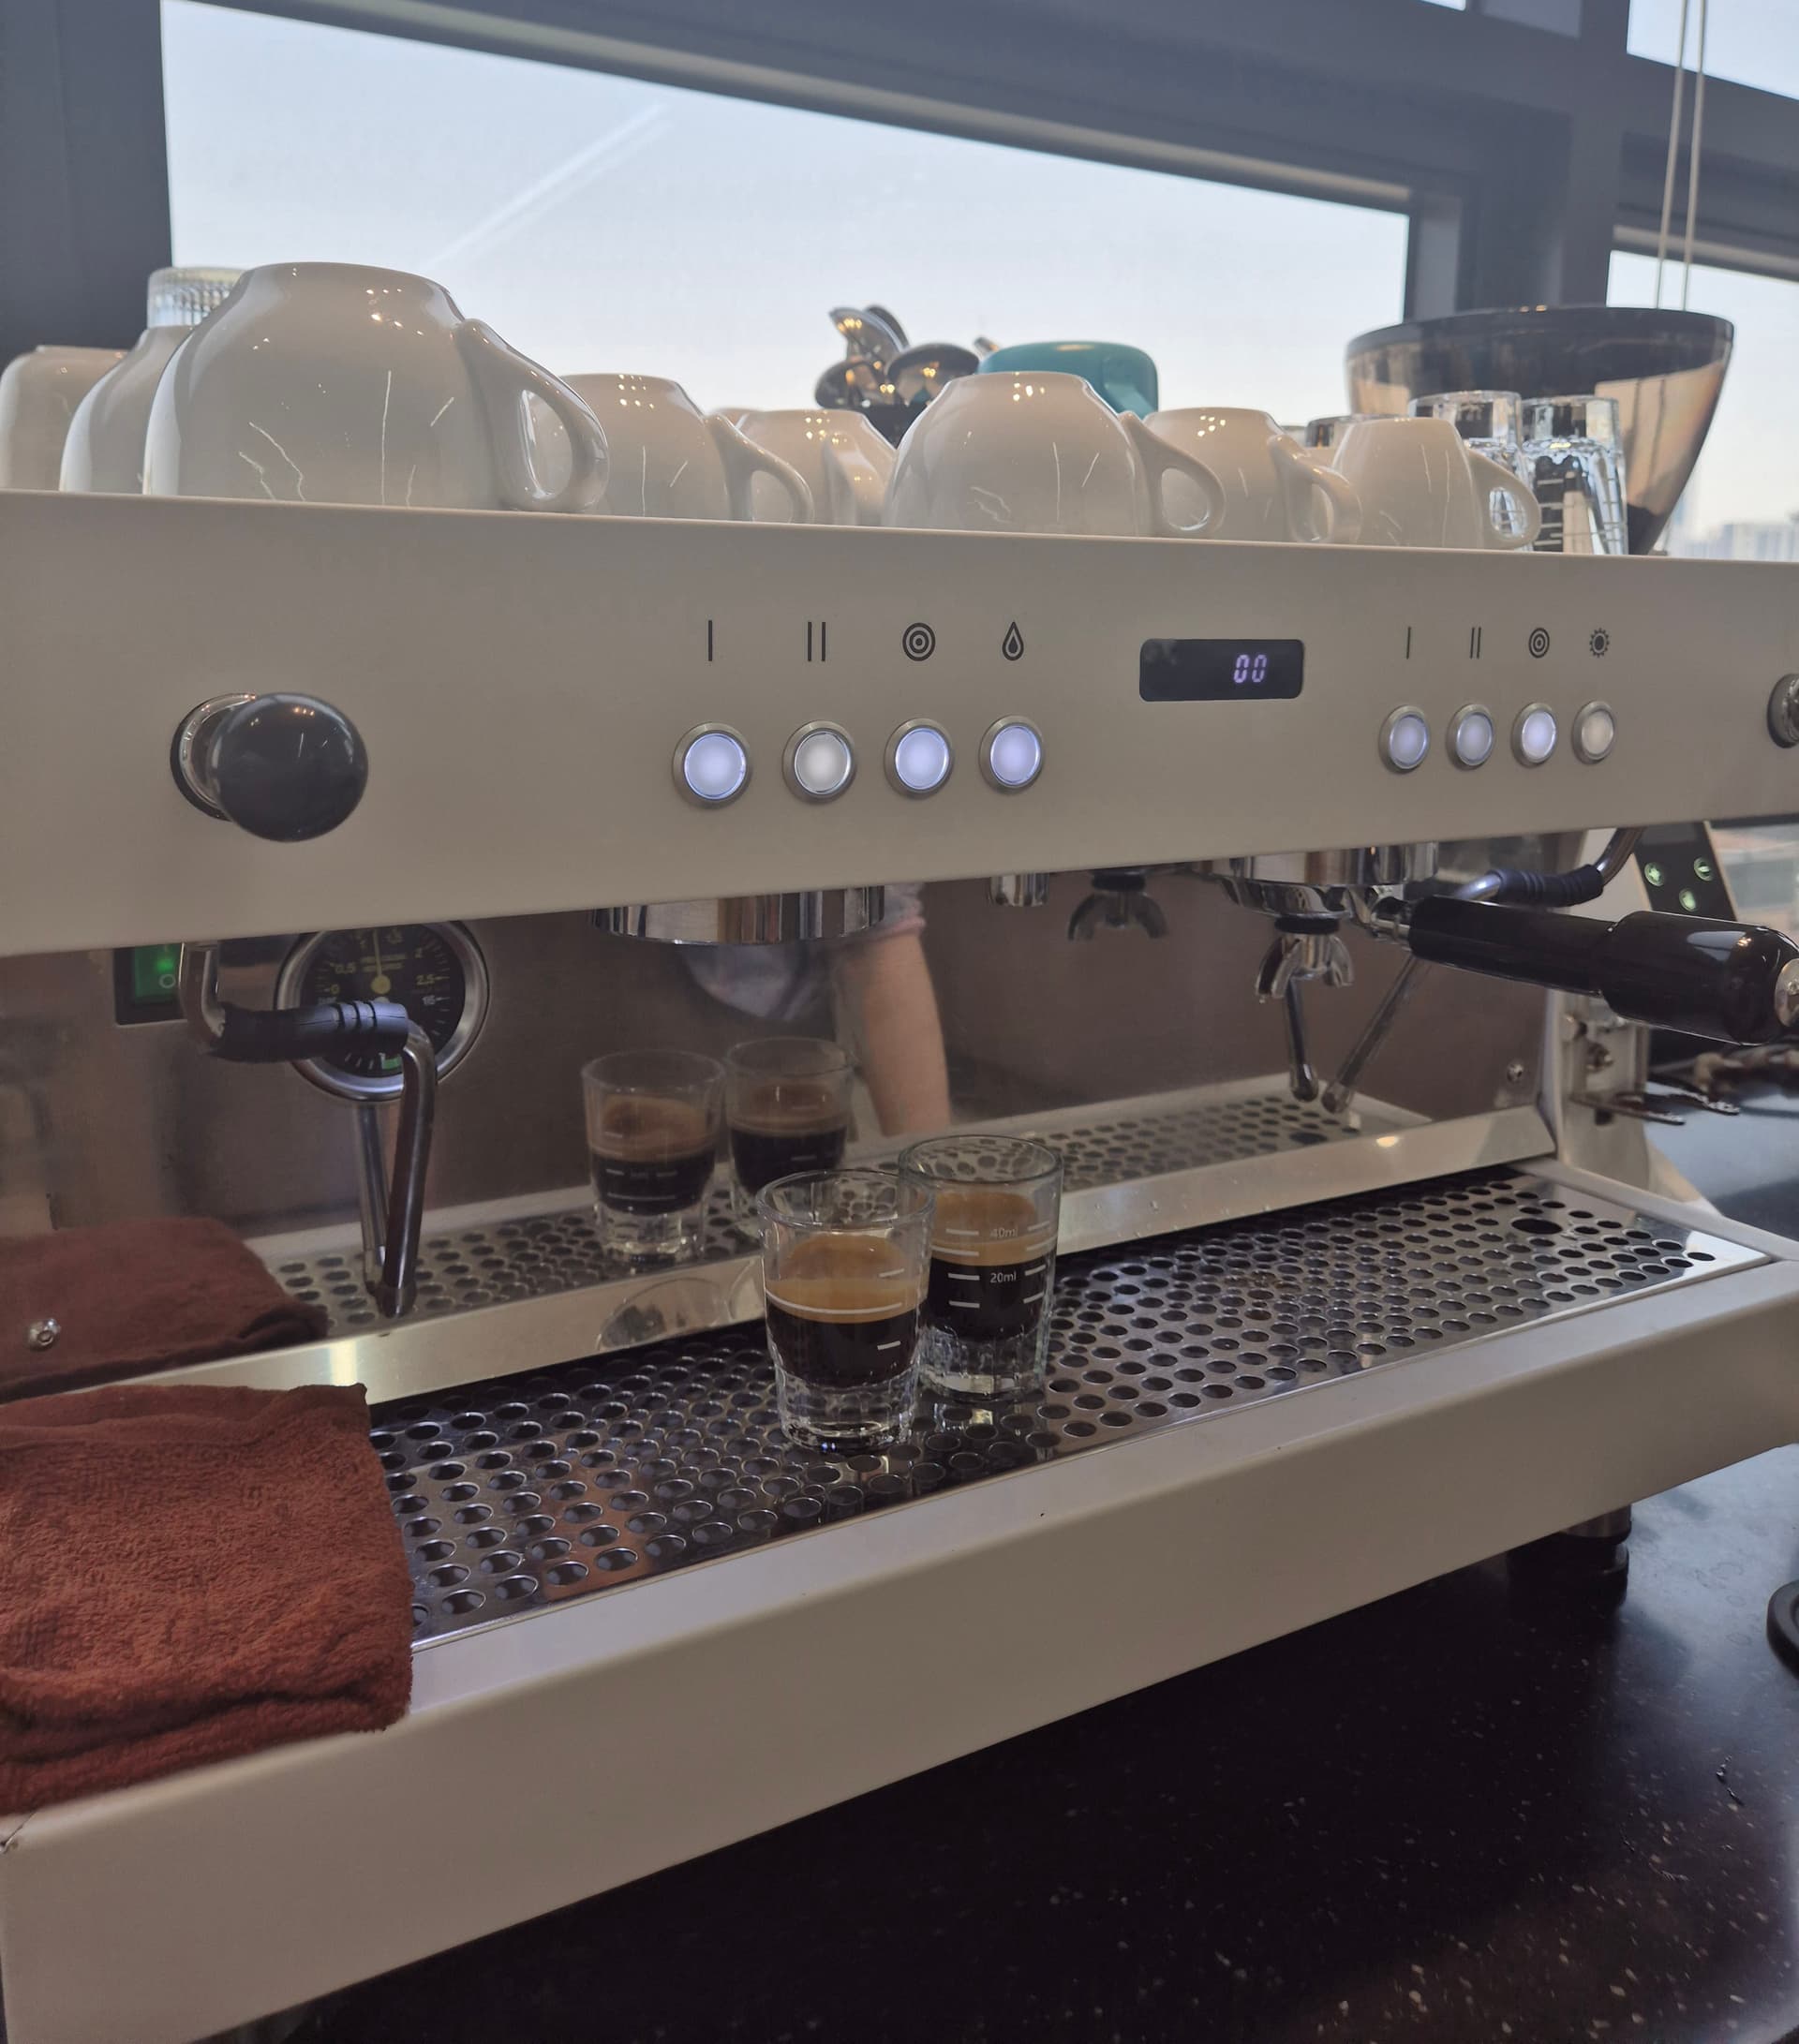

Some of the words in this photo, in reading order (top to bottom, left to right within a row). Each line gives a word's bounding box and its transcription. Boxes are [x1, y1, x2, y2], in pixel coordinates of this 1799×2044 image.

[1233, 654, 1268, 684] 00
[989, 1224, 1018, 1237] 40ml
[989, 1269, 1018, 1283] 20ml
